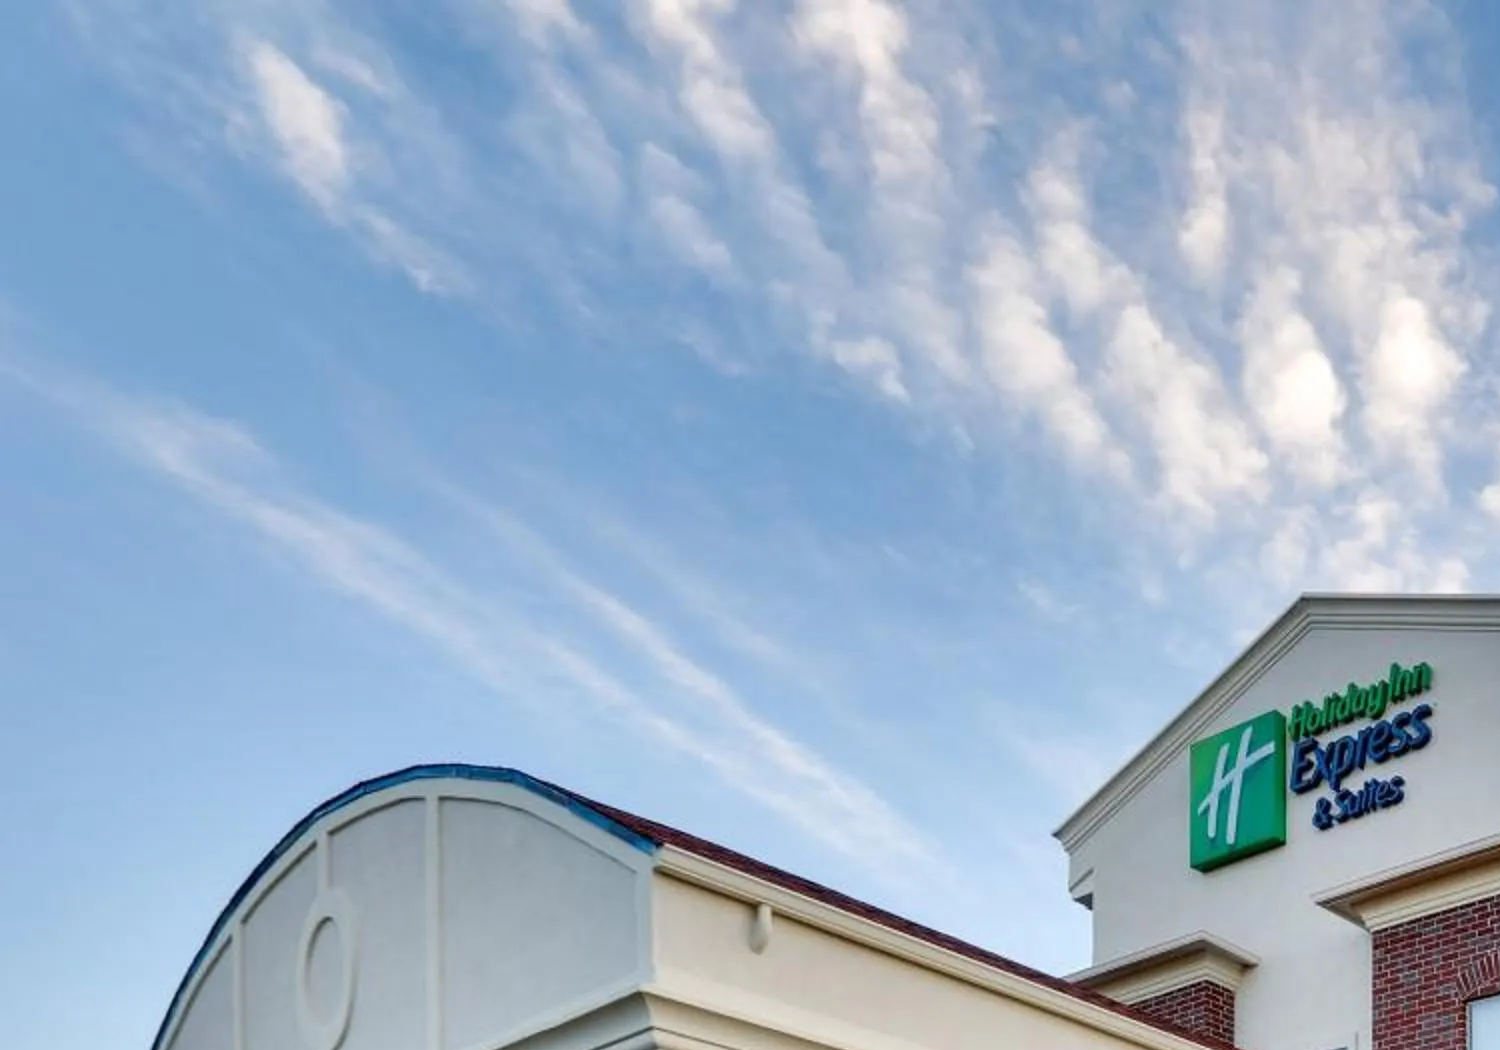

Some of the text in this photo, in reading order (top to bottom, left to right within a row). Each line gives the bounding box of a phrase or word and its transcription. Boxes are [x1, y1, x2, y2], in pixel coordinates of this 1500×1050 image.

[1289, 662, 1433, 741] Holiday Inn
[1290, 704, 1433, 795] Express
[1312, 776, 1405, 830] & Suites
